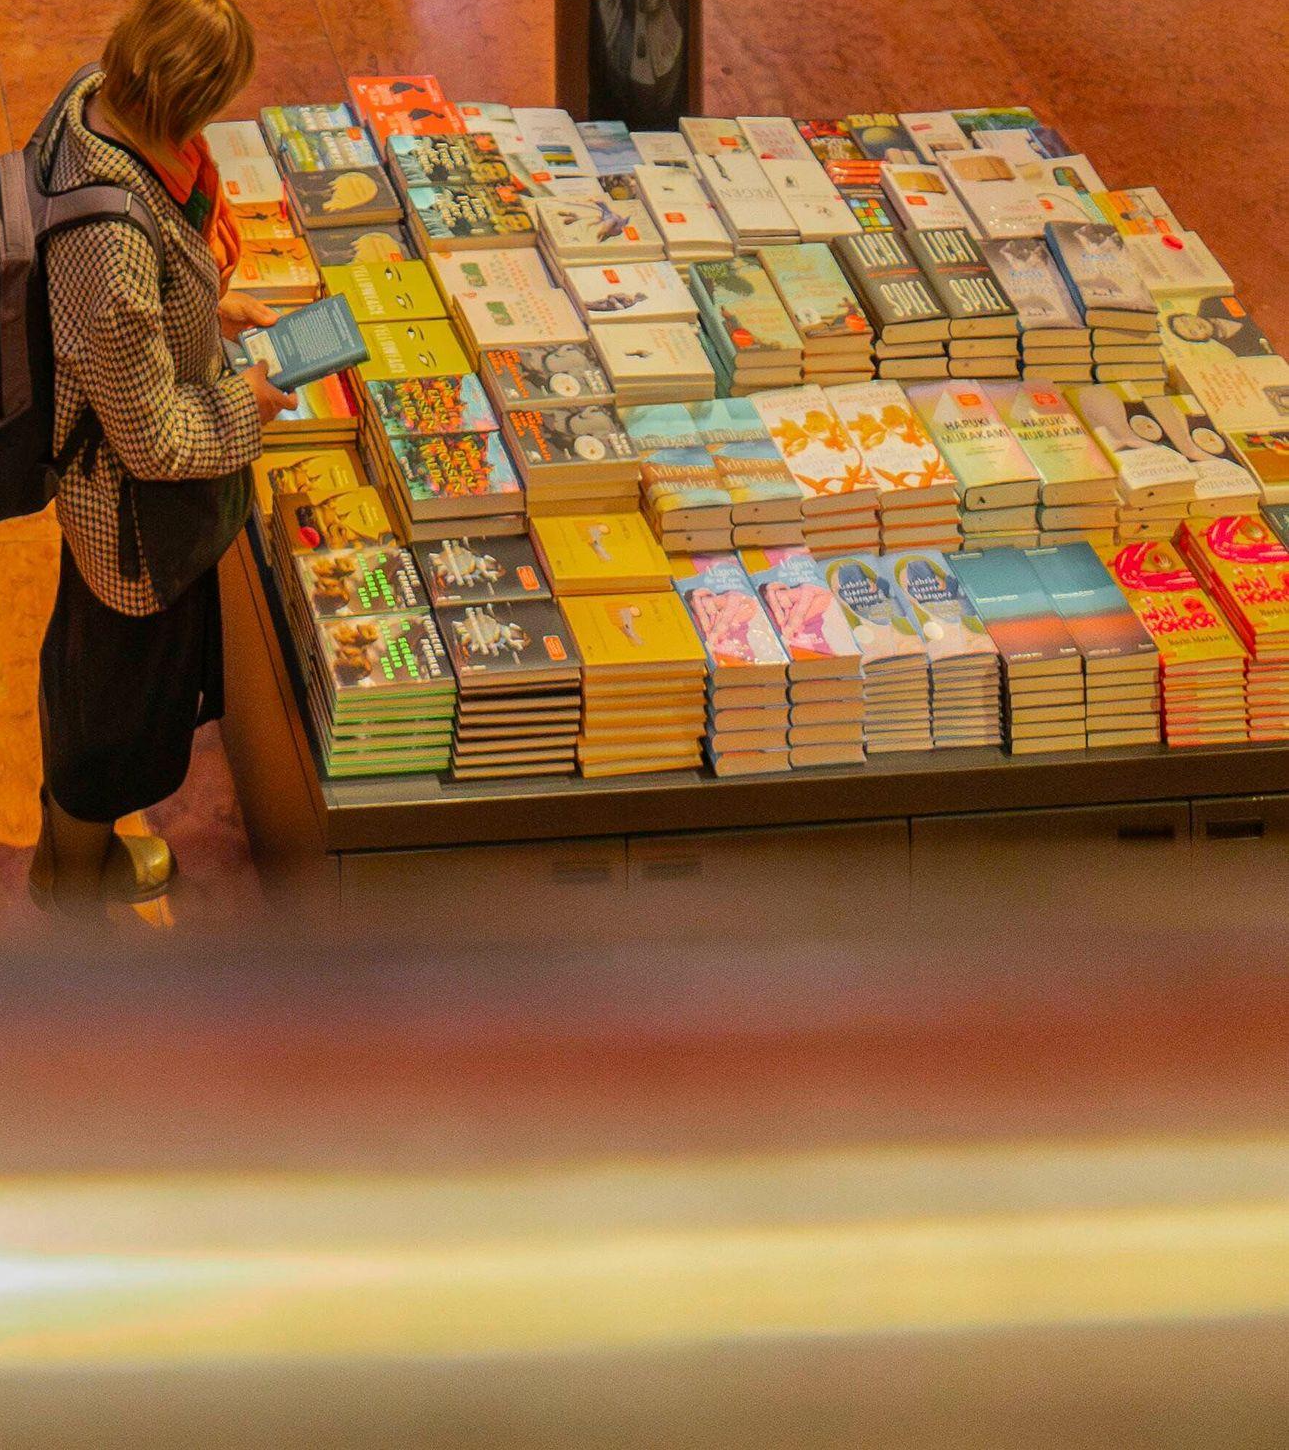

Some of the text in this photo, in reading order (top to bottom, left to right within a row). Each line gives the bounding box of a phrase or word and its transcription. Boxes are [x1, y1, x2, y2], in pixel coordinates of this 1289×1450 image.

[848, 231, 909, 268] LICHT
[918, 230, 980, 264] LICHT
[879, 280, 941, 318] SPIEL
[948, 277, 1011, 313] SPIEL
[943, 417, 991, 431] HARUKI
[1017, 424, 1088, 442] MURAKAMI
[1020, 414, 1067, 429] HARUKI
[940, 427, 1011, 445] MURAKAMI
